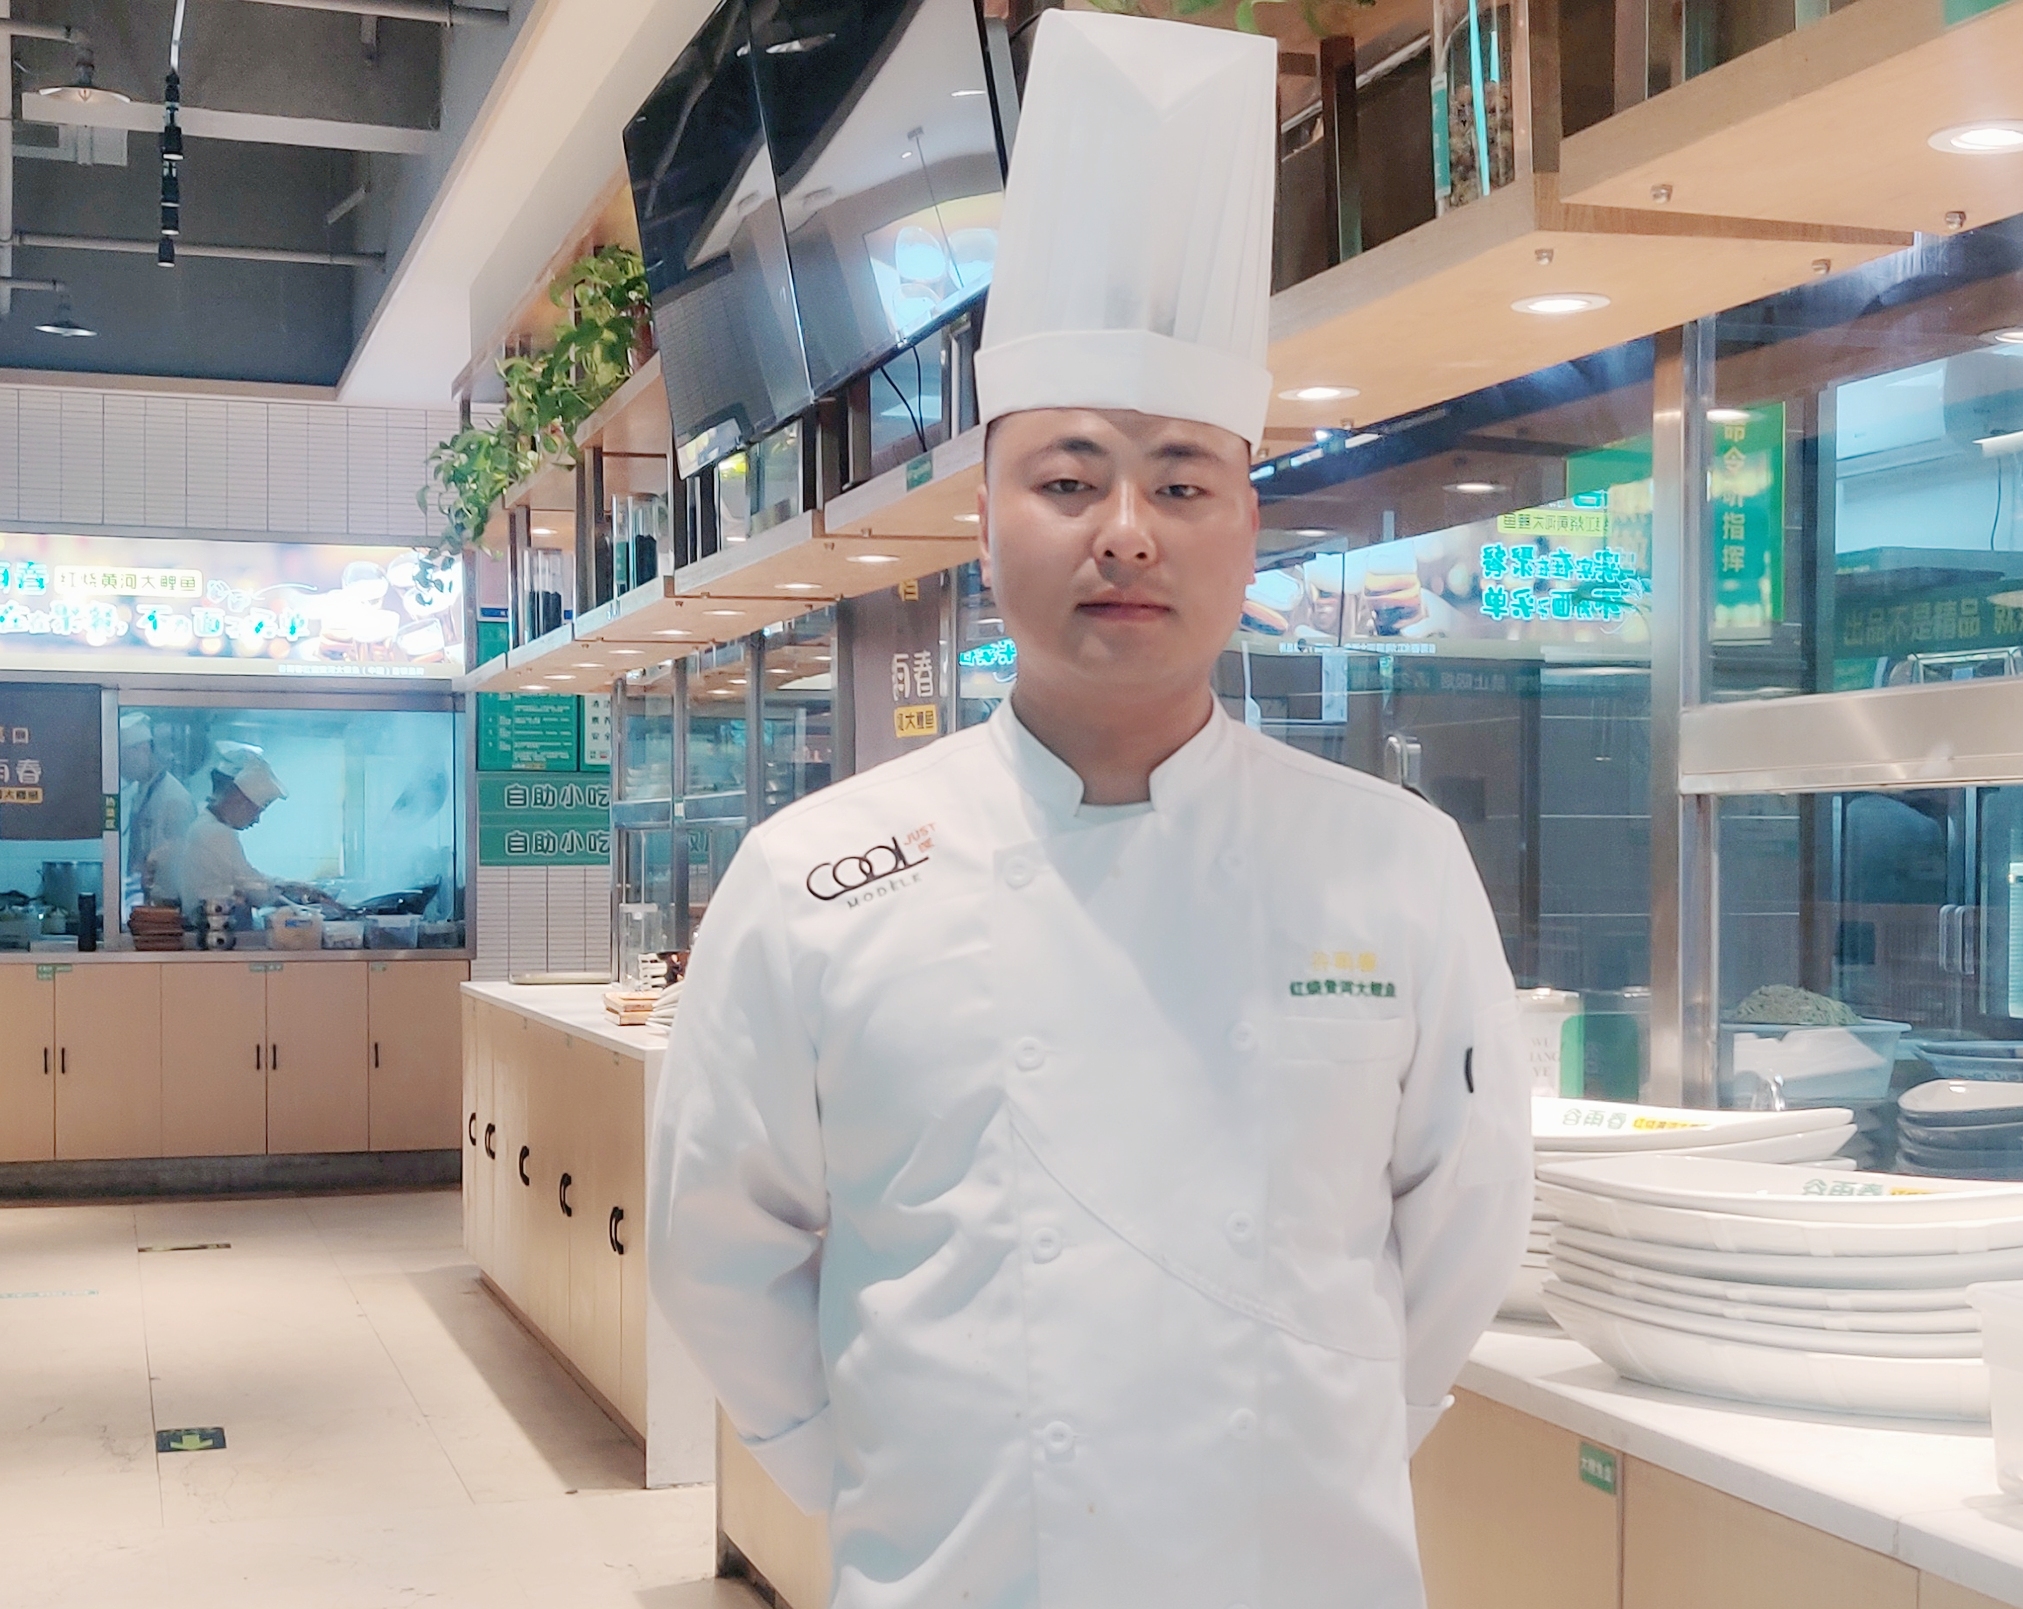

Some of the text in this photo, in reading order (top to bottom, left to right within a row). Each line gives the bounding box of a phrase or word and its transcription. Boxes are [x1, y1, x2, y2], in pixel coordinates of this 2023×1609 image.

[504, 783, 611, 810] 自助小吃
[504, 829, 611, 856] 自助小吃
